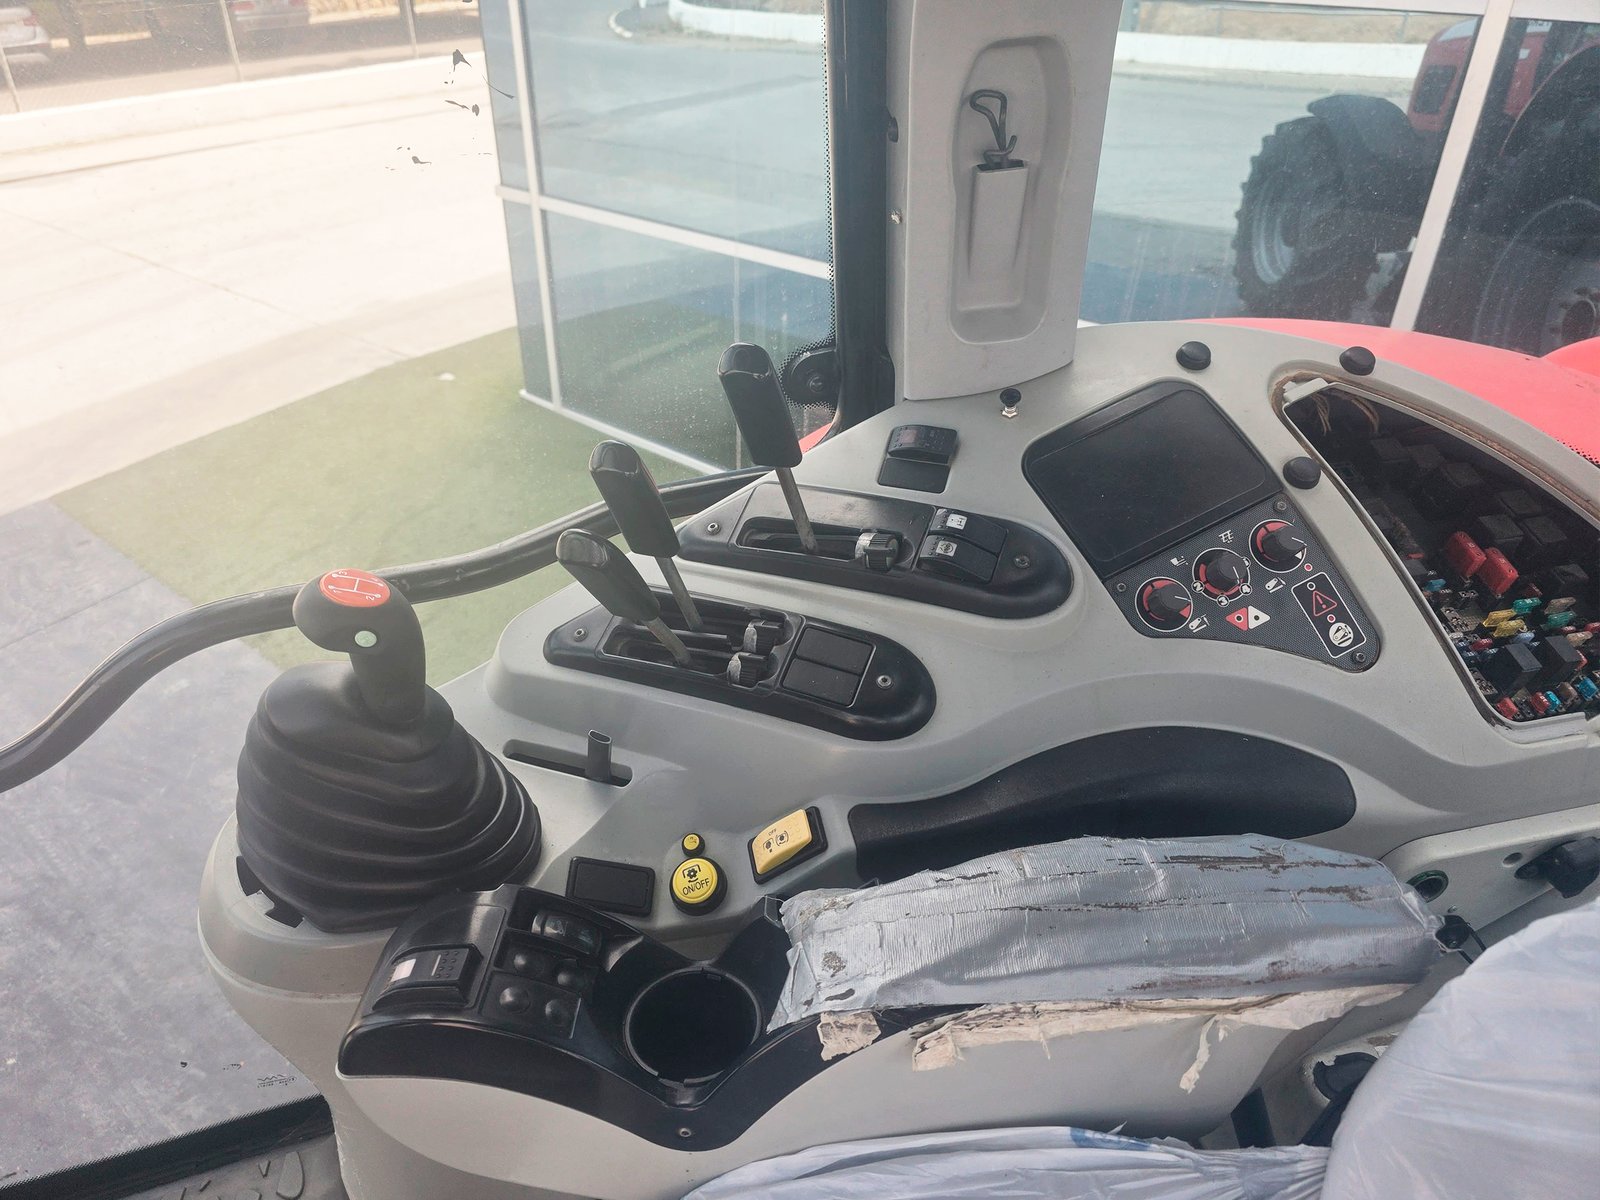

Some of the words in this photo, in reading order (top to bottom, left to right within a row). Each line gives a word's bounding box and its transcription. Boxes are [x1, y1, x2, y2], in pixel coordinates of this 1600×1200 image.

[1193, 582, 1203, 592] 2
[1218, 596, 1228, 606] 3
[682, 877, 710, 896] ON/OFF
